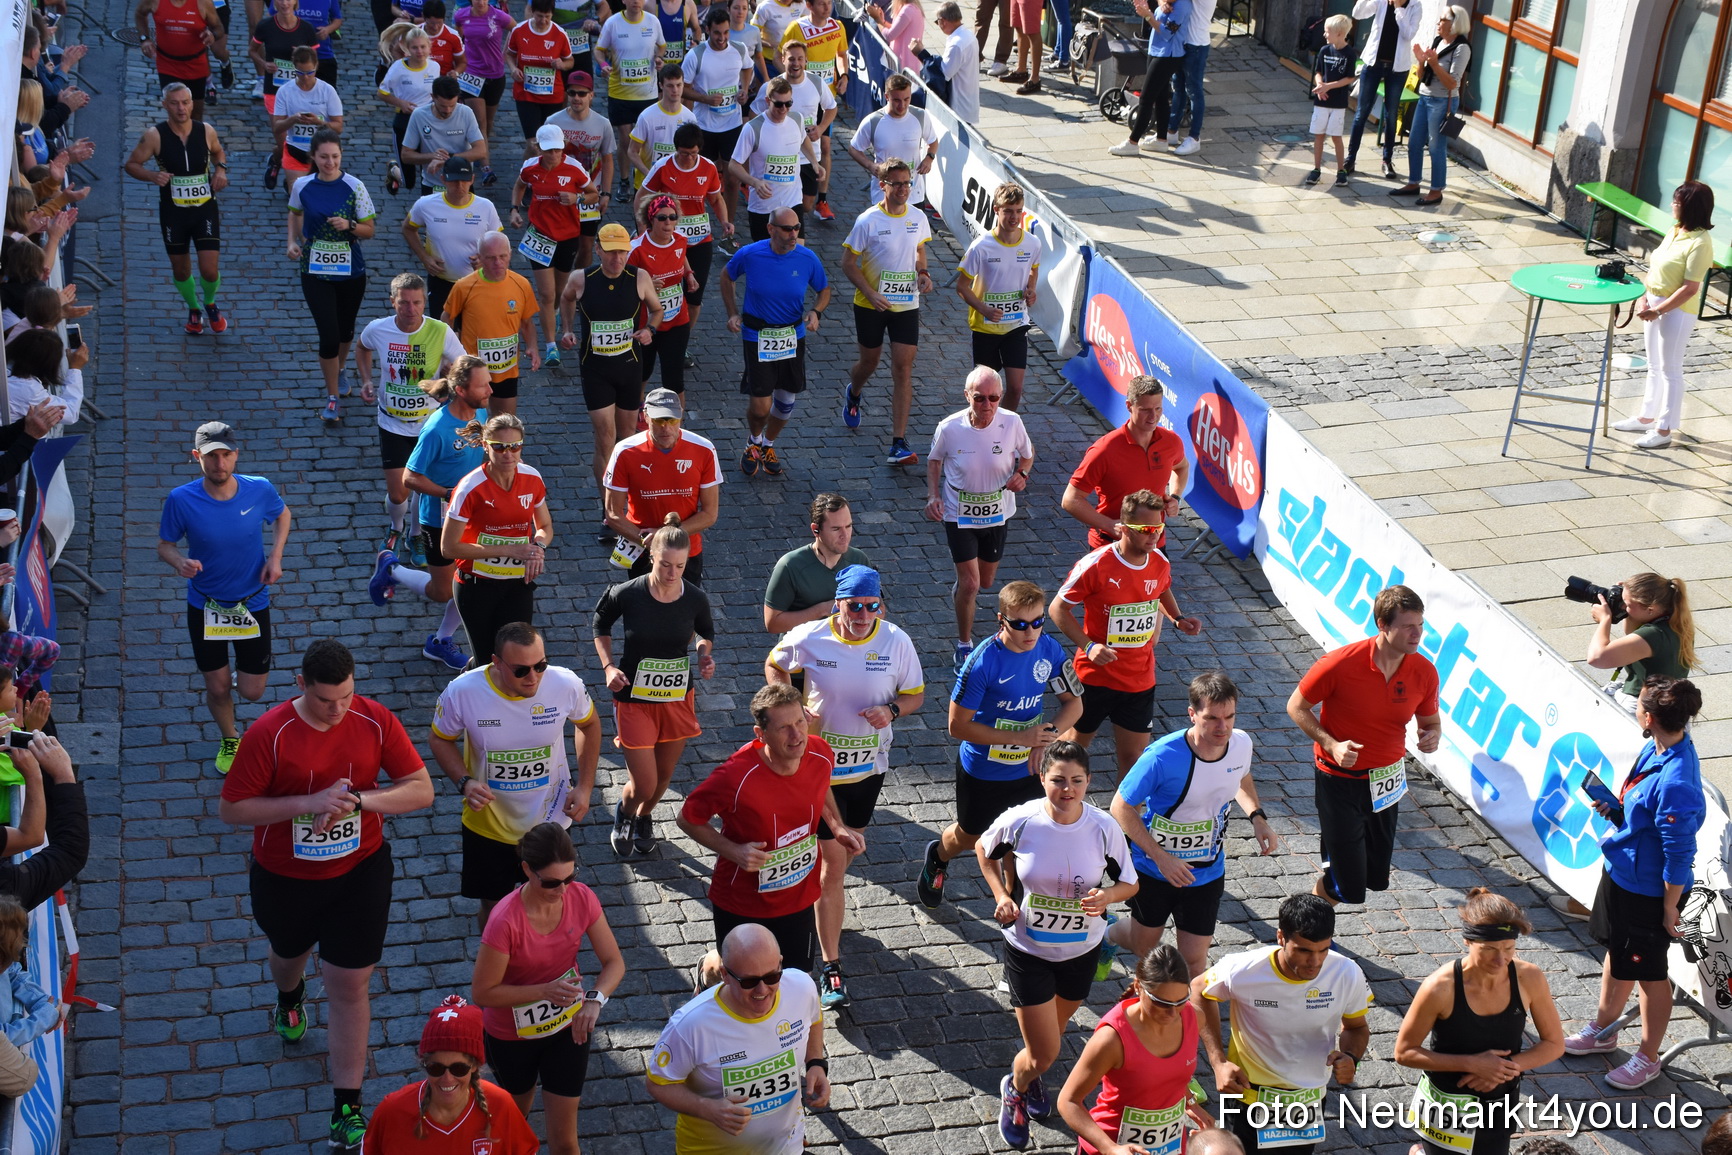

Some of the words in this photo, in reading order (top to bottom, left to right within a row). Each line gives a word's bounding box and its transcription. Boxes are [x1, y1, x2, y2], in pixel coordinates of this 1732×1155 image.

[296, 9, 322, 17] YSCAD
[807, 39, 823, 48] MAX
[663, 50, 680, 59] 203
[277, 70, 296, 79] 215
[624, 69, 648, 78] 1345
[527, 75, 553, 86] 2259
[769, 165, 794, 175] 2228
[176, 186, 208, 198] 1180
[962, 177, 999, 231] SW
[524, 235, 550, 256] 2136
[315, 252, 347, 264] 2605
[884, 272, 913, 283] BOCK
[884, 282, 911, 294] 2544
[986, 293, 1020, 303] BOCK
[593, 321, 630, 332] BOCK
[481, 337, 515, 350] BOCK
[597, 334, 629, 347] 1254
[763, 338, 793, 351] 2224
[1088, 300, 1143, 378] Hervis
[388, 351, 426, 359] GLETSCHER
[484, 346, 516, 362] 1015
[387, 358, 426, 366] MARATHON
[1150, 352, 1173, 378] STORE
[390, 395, 425, 409] 1099
[396, 410, 419, 418] FRANZ
[1196, 398, 1255, 495] Hervis
[962, 493, 1000, 503] BOCK
[963, 503, 999, 516] 2082
[1115, 603, 1156, 615] BOCK
[211, 611, 253, 626] 1384
[1115, 616, 1153, 632] 1248
[1118, 634, 1148, 643] MARCEL
[866, 653, 878, 661] 20
[642, 660, 687, 671] BOCK
[643, 673, 684, 688] 1068
[647, 690, 672, 698] JULIA
[996, 693, 1043, 712] #LÄUF
[532, 705, 545, 715] 20
[531, 713, 560, 721] Neumarkter
[532, 718, 556, 727] Stadtlauf
[827, 736, 876, 747] BOCK
[493, 750, 547, 763] BOCK
[836, 751, 872, 765] 817
[494, 762, 544, 780] 2349
[499, 782, 539, 791] SAMUEL
[1156, 819, 1208, 833] BOCK
[1156, 833, 1205, 849] 2192
[301, 841, 354, 855] MATTHIAS
[767, 852, 812, 881] 2569
[768, 867, 811, 888] GERHARD
[1032, 911, 1085, 931] 2773
[1306, 990, 1319, 998] 20
[524, 1000, 576, 1025] 129
[536, 1014, 569, 1034] SONJA
[777, 1022, 790, 1035] 20
[781, 1034, 803, 1049] Stadtlauf
[720, 1051, 747, 1063] BOCK
[730, 1052, 792, 1082] BOCK
[750, 1098, 782, 1115] ALPH
[1130, 1106, 1183, 1124] BOCK
[1127, 1122, 1180, 1145] 2612
[1263, 1127, 1320, 1139] HAZBULLAH
[1420, 1122, 1454, 1144] BIRGIT
